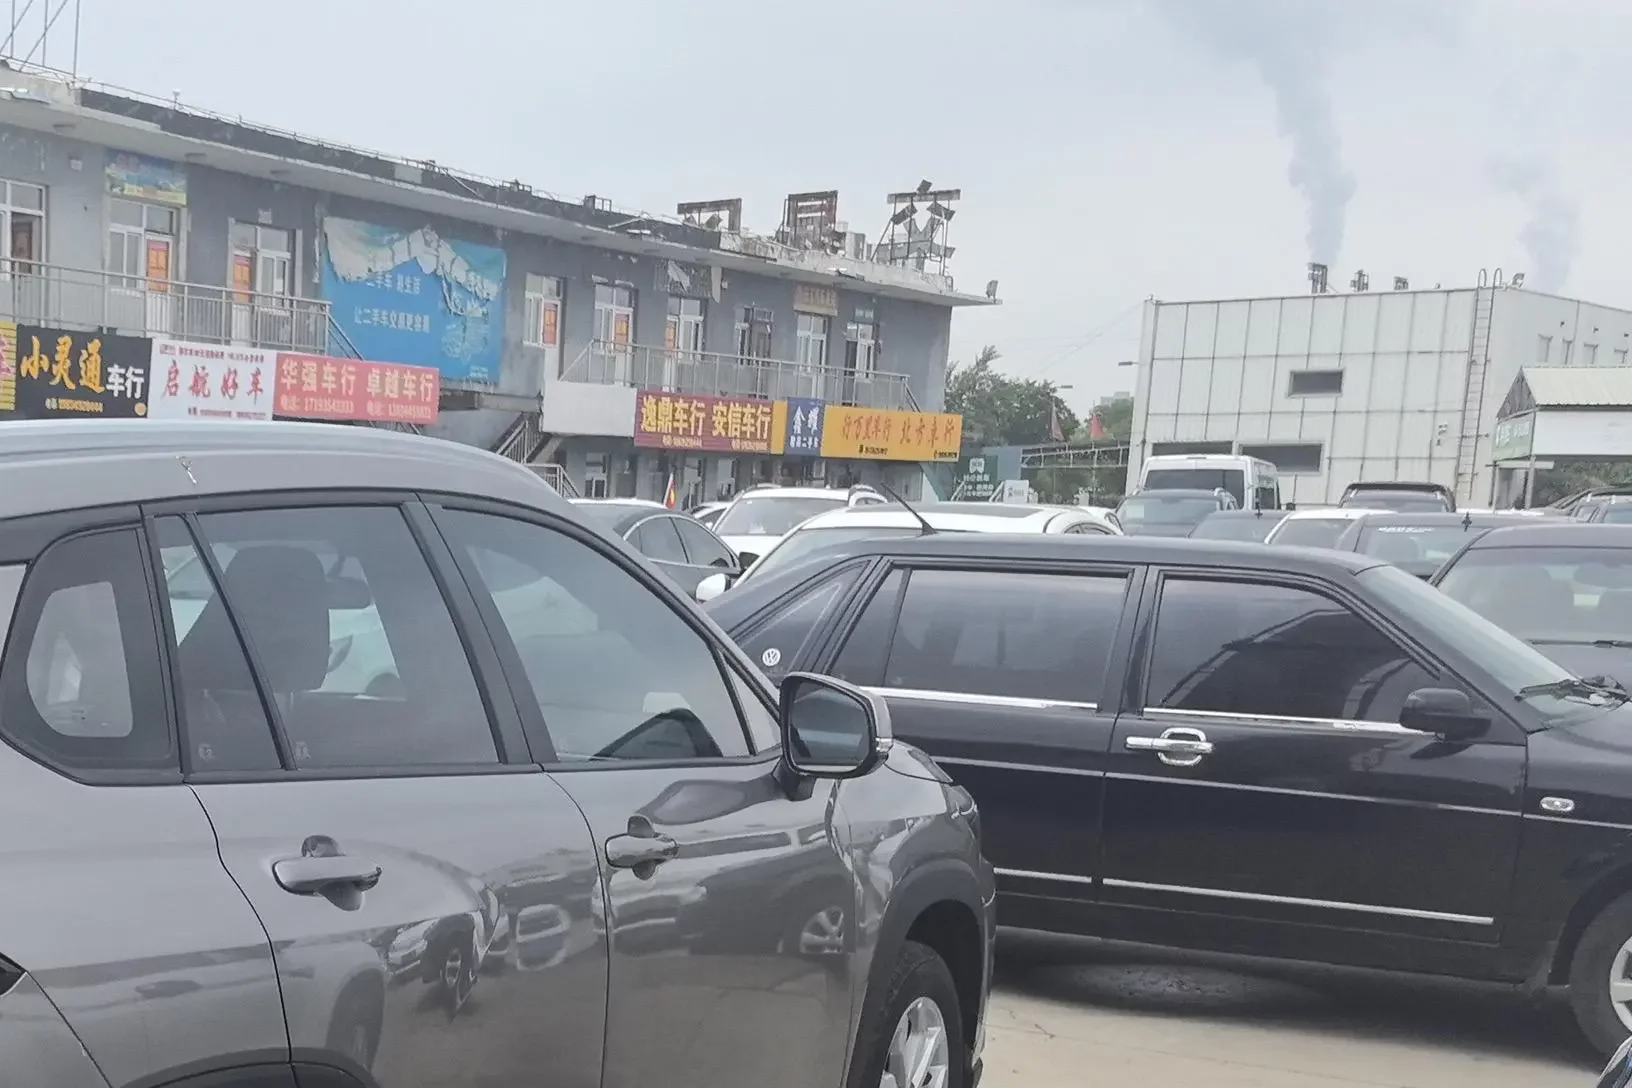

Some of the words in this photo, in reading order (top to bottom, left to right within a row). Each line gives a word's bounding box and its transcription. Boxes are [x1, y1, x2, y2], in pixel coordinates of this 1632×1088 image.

[280, 358, 357, 397] 华强车行
[366, 368, 434, 404] 卓越车行
[712, 401, 771, 440] 安信车行
